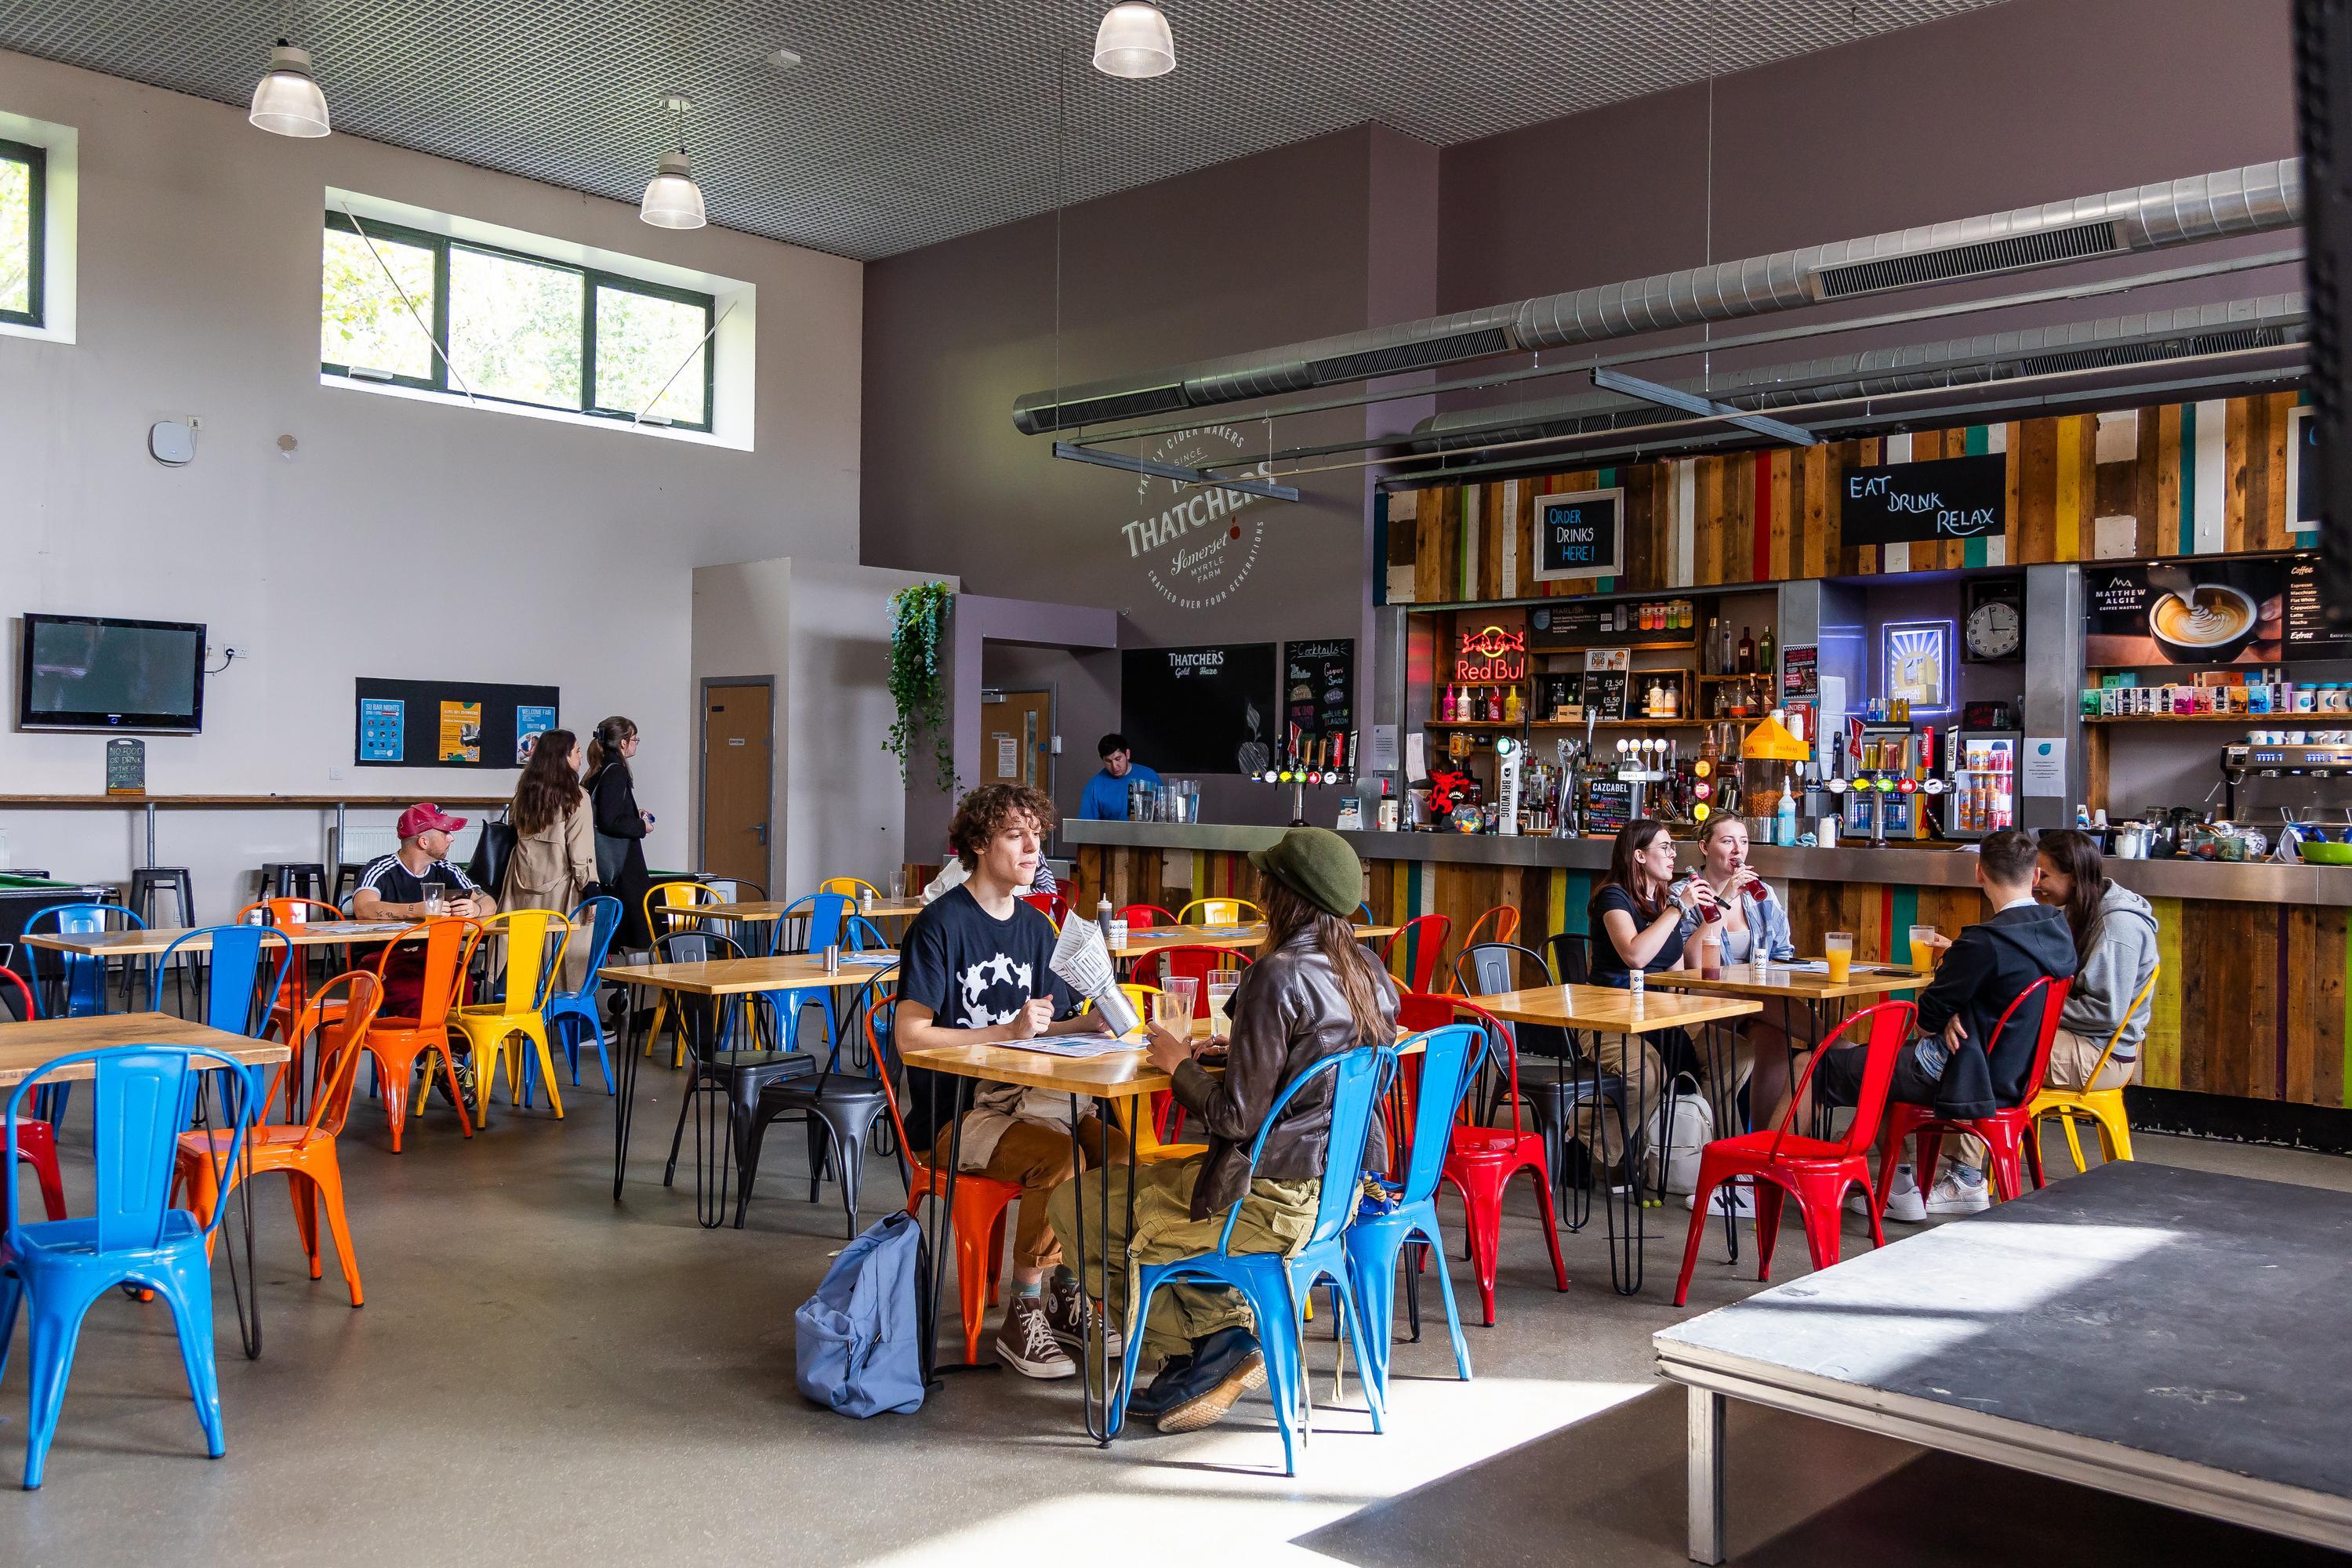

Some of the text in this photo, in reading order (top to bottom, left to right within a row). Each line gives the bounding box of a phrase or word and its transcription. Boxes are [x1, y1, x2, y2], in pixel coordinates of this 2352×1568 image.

[1167, 429, 1198, 449] CIDER
[1204, 426, 1244, 448] MAKERS
[1174, 447, 1203, 466] SINCE
[1850, 475, 1892, 499] EAT
[1887, 492, 1944, 514] DRINK
[1549, 508, 1581, 524] ORDER
[1936, 508, 1994, 535] RELAX
[1556, 526, 1595, 543] DRINKS
[1171, 531, 1229, 576] Somerset
[1148, 521, 1265, 609] CRAFTED OVER FOUR GENERATIONS
[1190, 556, 1225, 577] MYRTLE
[2291, 566, 2314, 575] Coffee
[1196, 568, 1221, 584] FARM
[1298, 642, 1339, 655] Cocktails
[1168, 652, 1224, 666] THATCHERS
[1457, 657, 1524, 680] Red Bul
[1174, 666, 1218, 679] Gold Haze
[122, 756, 142, 764] DRINK
[1592, 783, 1629, 793] CAZCABEL
[1501, 780, 1512, 818] BREWDOG
